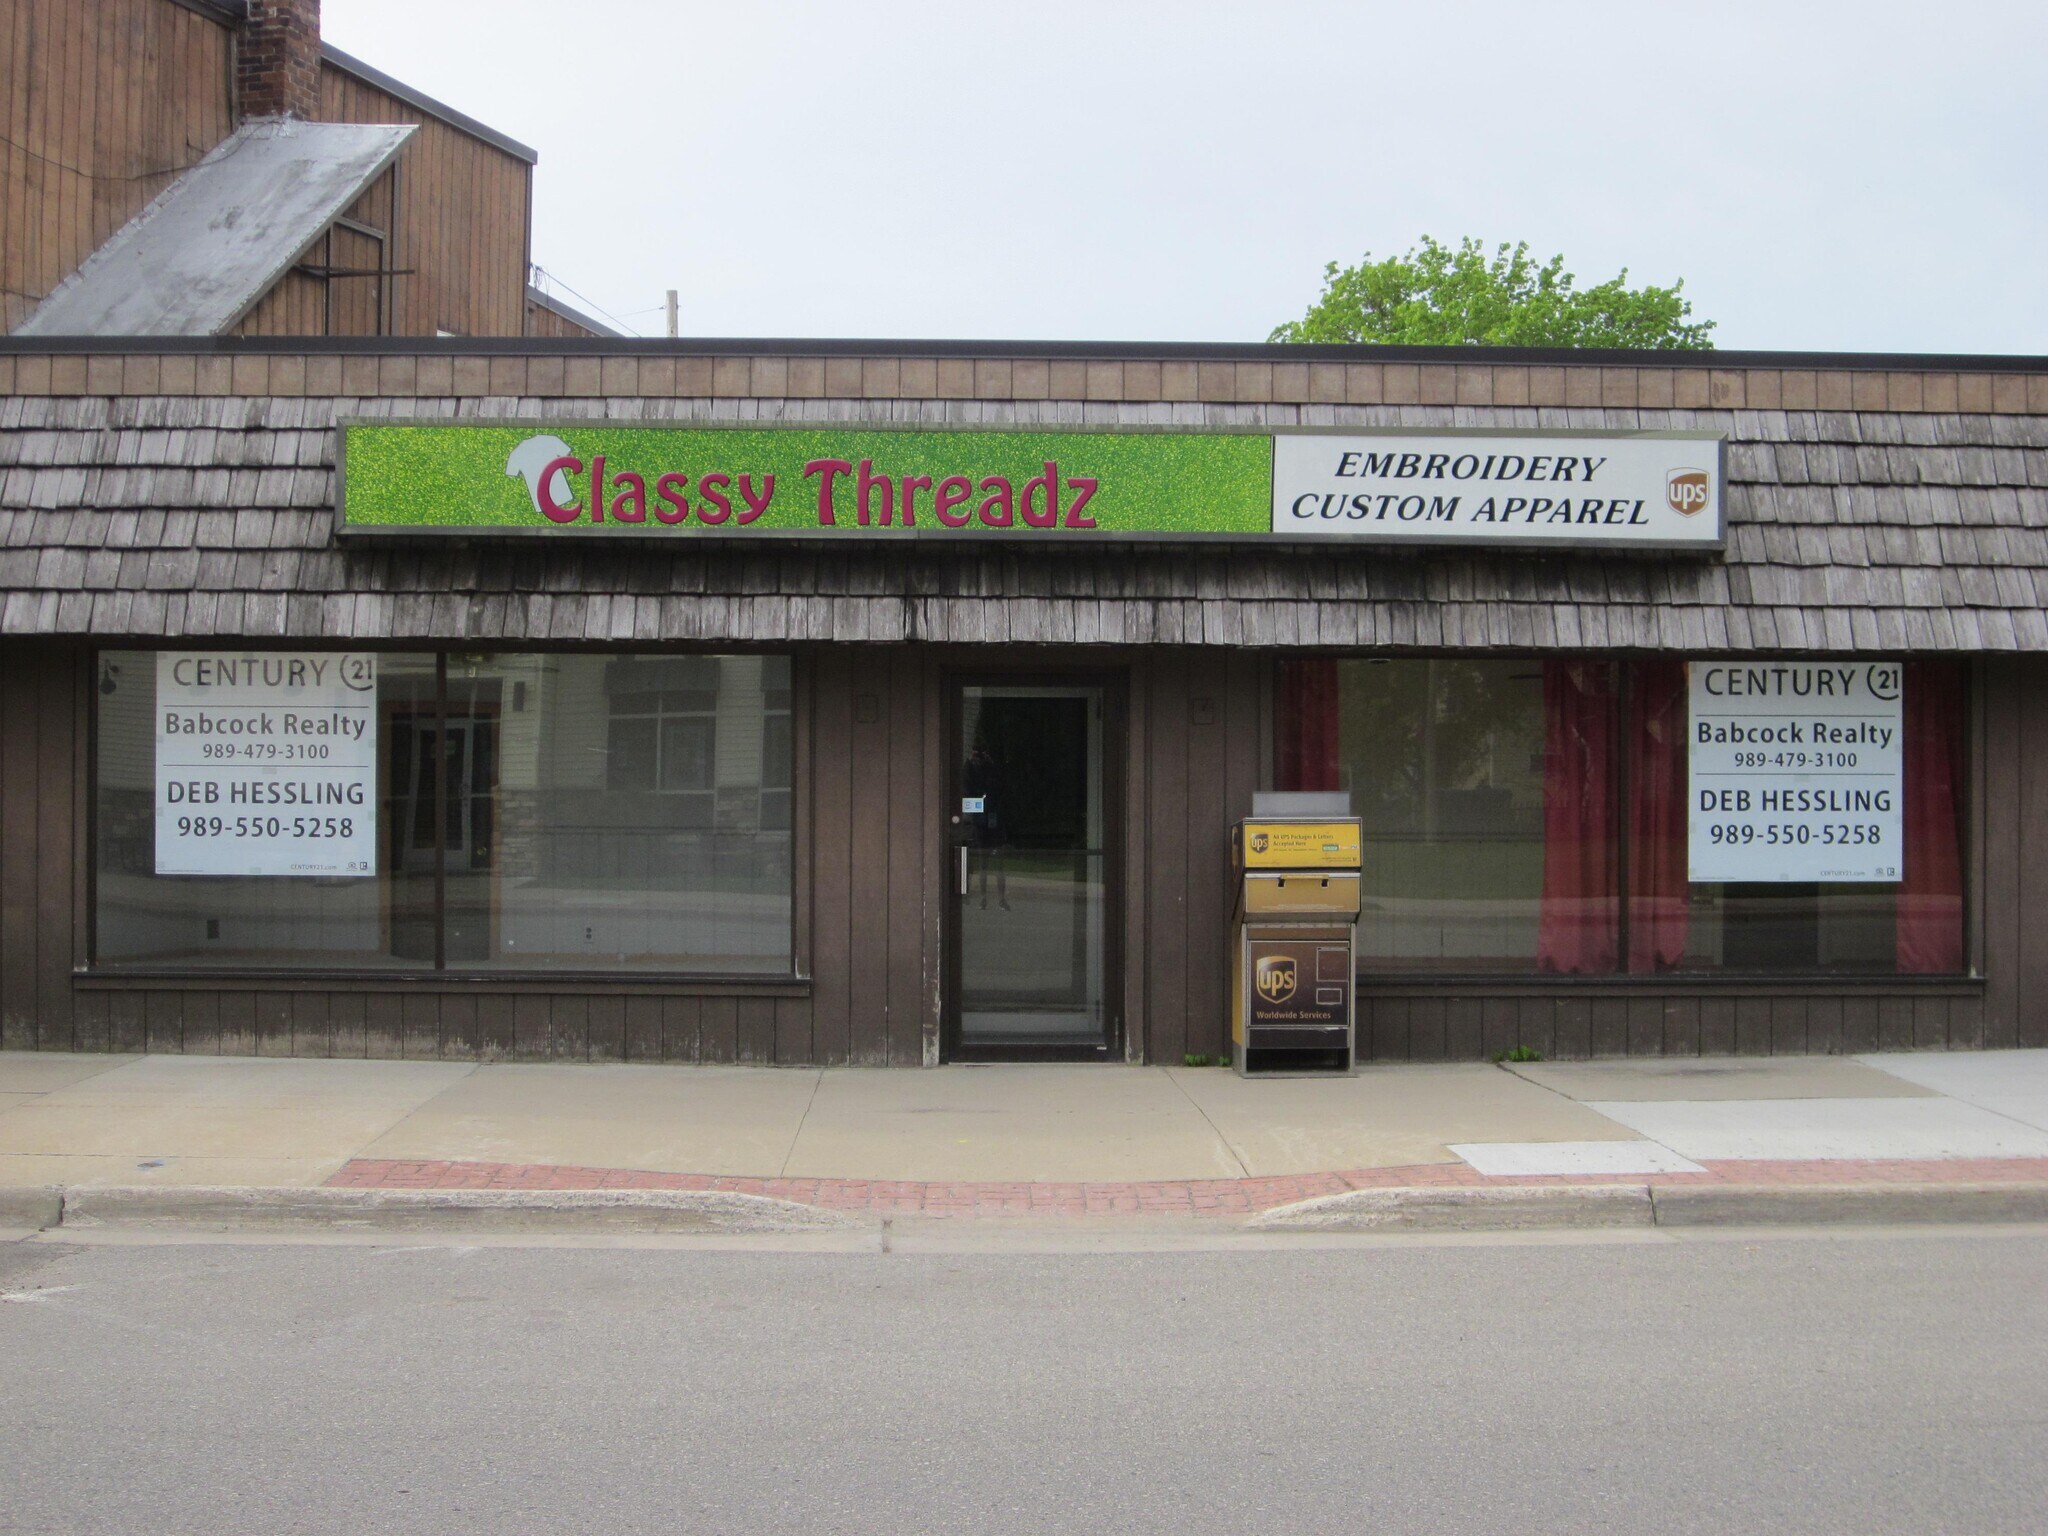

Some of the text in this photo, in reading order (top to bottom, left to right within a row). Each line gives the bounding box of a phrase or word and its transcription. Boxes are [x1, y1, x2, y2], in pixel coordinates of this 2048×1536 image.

[1335, 452, 1607, 482] EMBROIDERY
[536, 455, 1098, 528] Classy Threadz
[1670, 481, 1706, 509] ups
[1291, 493, 1650, 525] CUSTOM APPAREL
[173, 658, 373, 687] CENTURY 21
[1705, 668, 1899, 696] CENTURY 21
[165, 712, 366, 741] Babcock Realty
[1697, 721, 1893, 749] Babcock Realty
[203, 743, 329, 759] 989-479-3100
[1734, 752, 1857, 767] 989-479-3100
[167, 781, 364, 805] DEB HESSLING
[1700, 789, 1891, 812] DEB HESSLING
[178, 816, 353, 838] 989-550-5258
[1710, 824, 1881, 845] 989-550-5258
[1251, 838, 1268, 851] ups
[1259, 970, 1294, 997] ups
[1256, 1011, 1331, 1019] Worldwide Services
